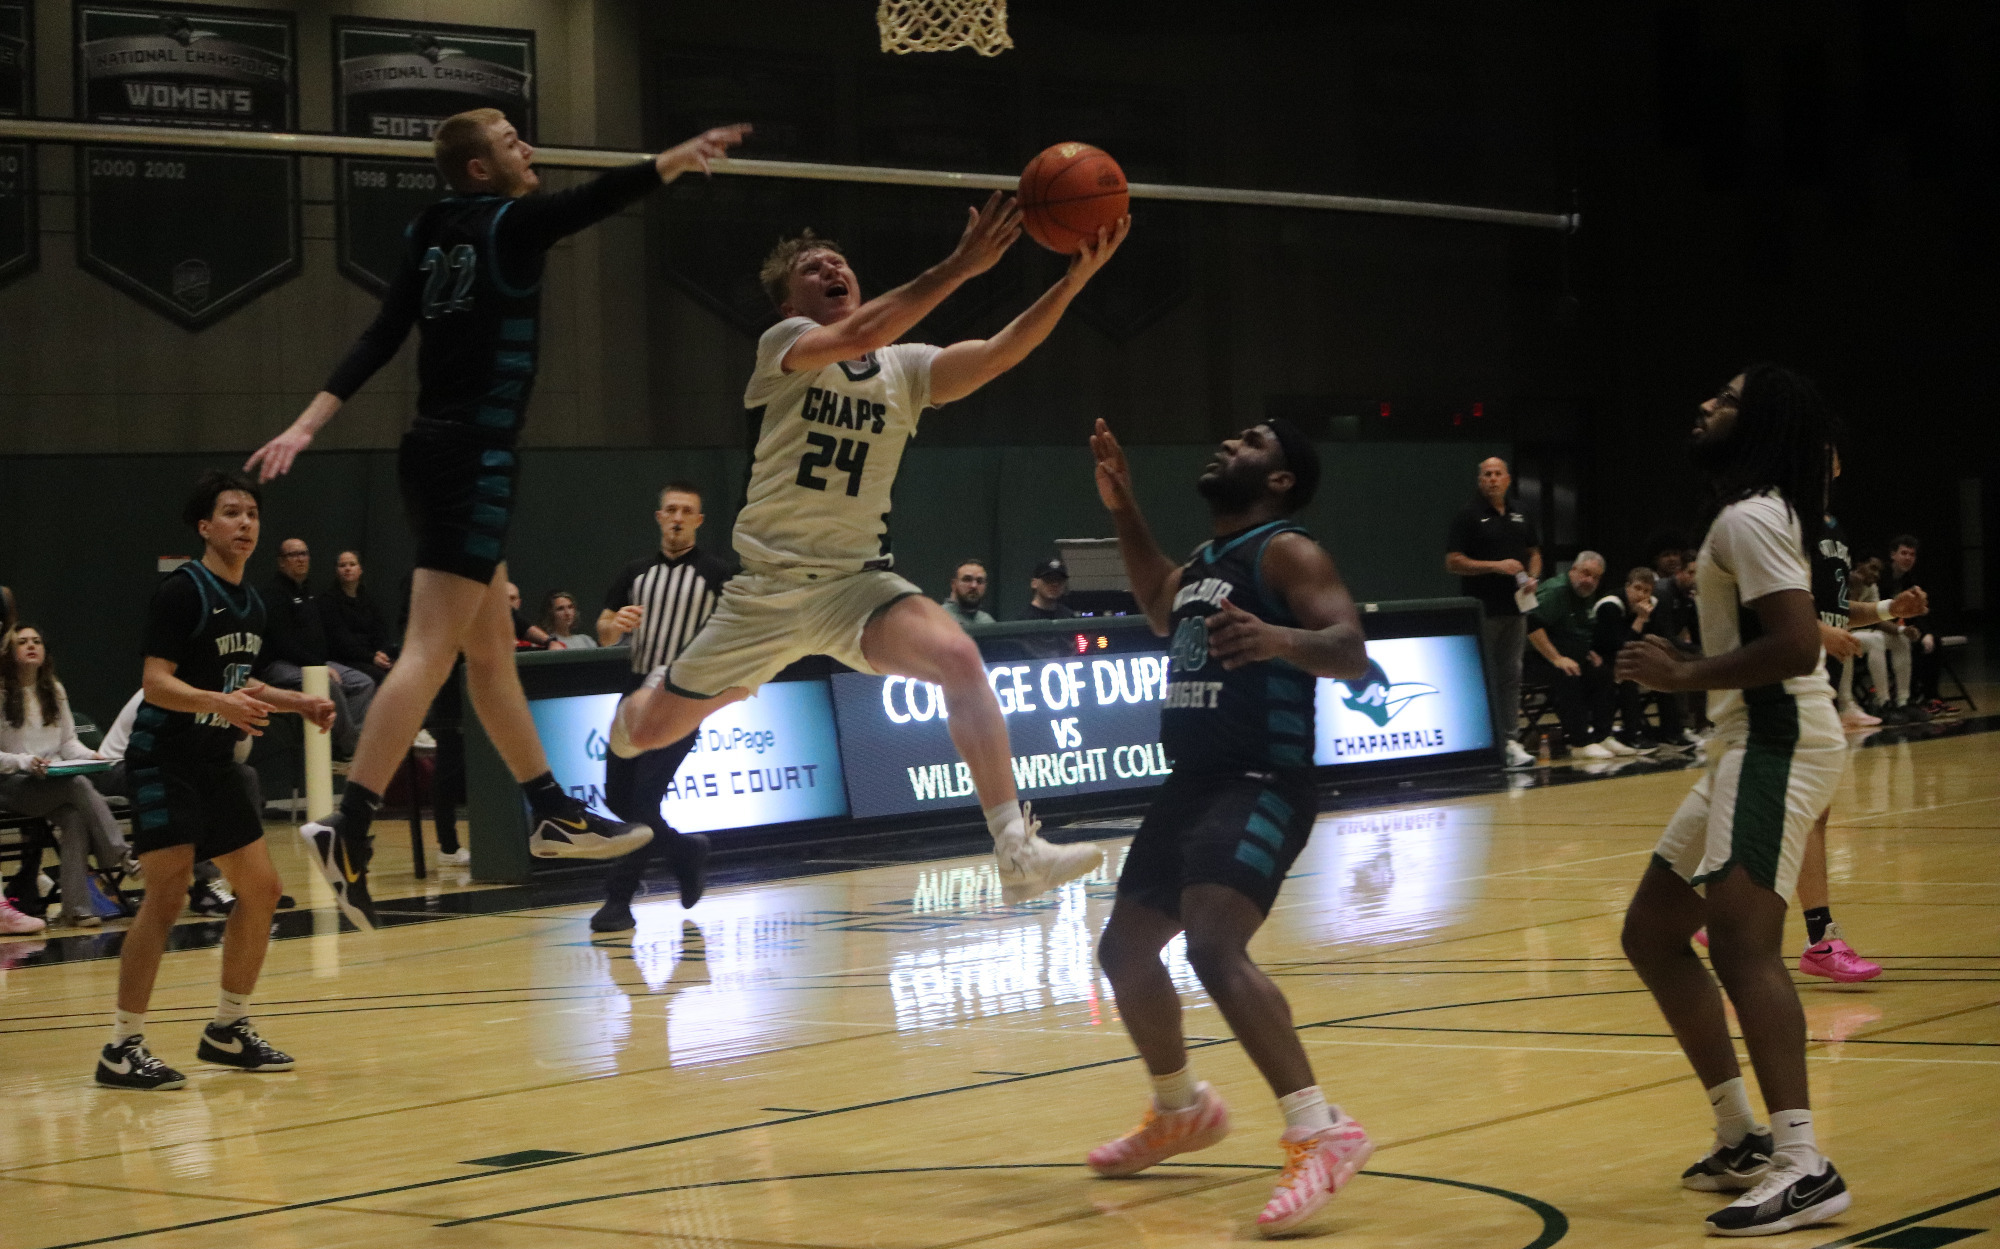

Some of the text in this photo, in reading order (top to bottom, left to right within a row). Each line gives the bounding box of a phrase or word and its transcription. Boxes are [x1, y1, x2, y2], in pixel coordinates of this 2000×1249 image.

[99, 49, 177, 67] NATIONAL
[354, 65, 427, 82] NATIONAL
[125, 83, 252, 113] WOMEN'S
[371, 116, 441, 137] SOFT
[92, 159, 186, 179] 2000 2002
[352, 170, 387, 188] 1998
[396, 172, 436, 190] 2000
[419, 244, 477, 319] 22
[801, 387, 886, 434] CHAPS
[795, 431, 869, 497] 24
[882, 666, 1036, 724] COLGE
[1040, 662, 1086, 711] OF
[709, 727, 775, 754] DuPage
[1050, 717, 1082, 749] VS
[1333, 729, 1444, 756] CHAPARRALS
[569, 764, 818, 808] ON AAS COURT
[907, 742, 1174, 801] WILB WRIGHT COLL
